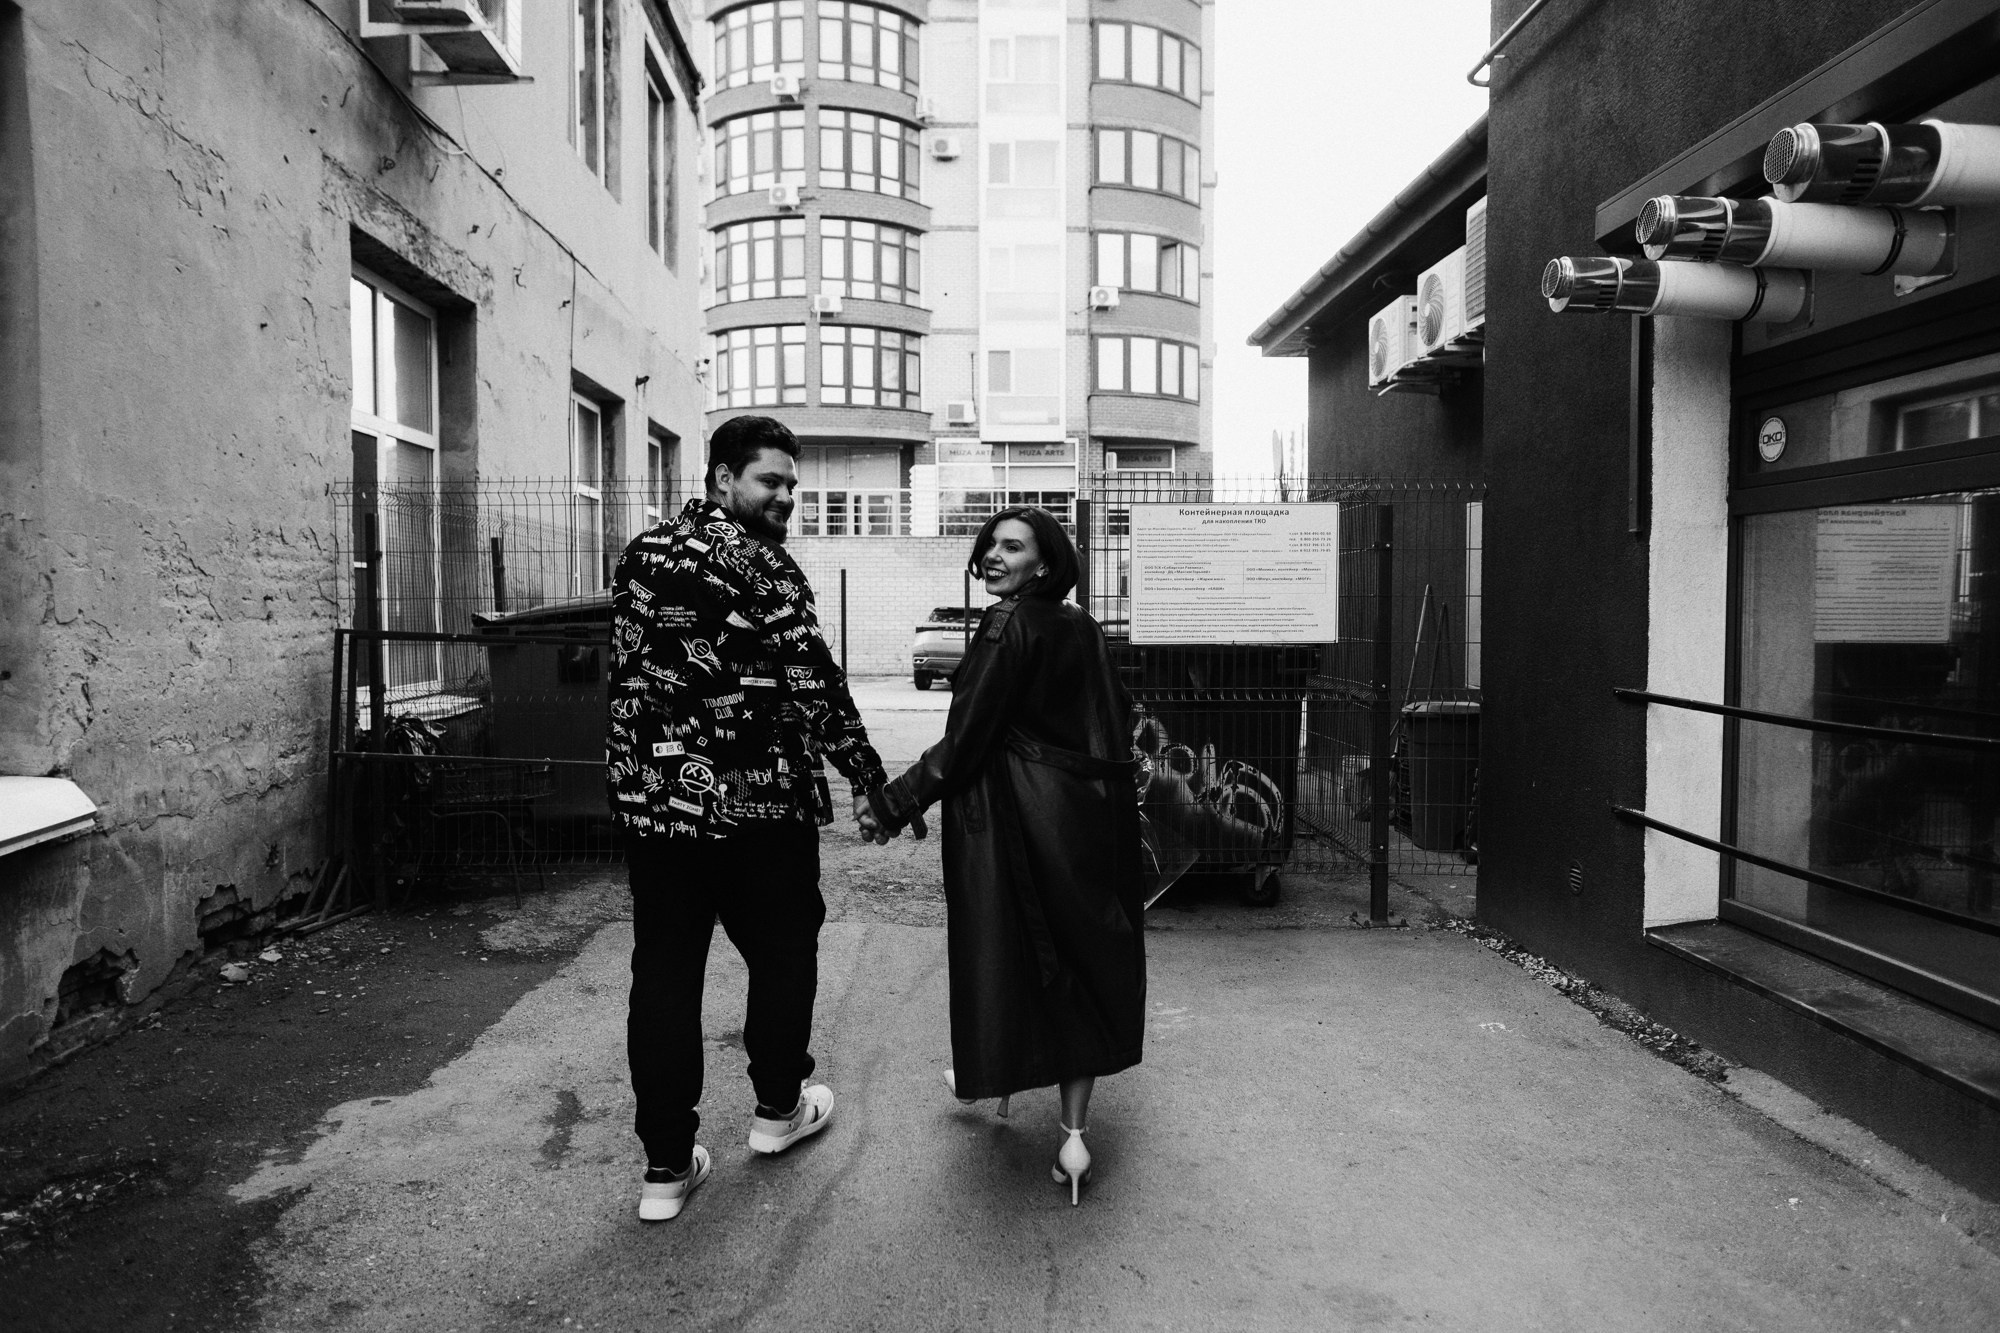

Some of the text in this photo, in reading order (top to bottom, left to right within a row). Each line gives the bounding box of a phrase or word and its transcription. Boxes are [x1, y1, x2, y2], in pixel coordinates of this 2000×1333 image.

[1179, 508, 1242, 517] Контейнерная
[630, 598, 655, 620] UNDER
[786, 667, 813, 679] GROU
[702, 690, 745, 708] TOMORROW
[714, 706, 734, 720] CLUB
